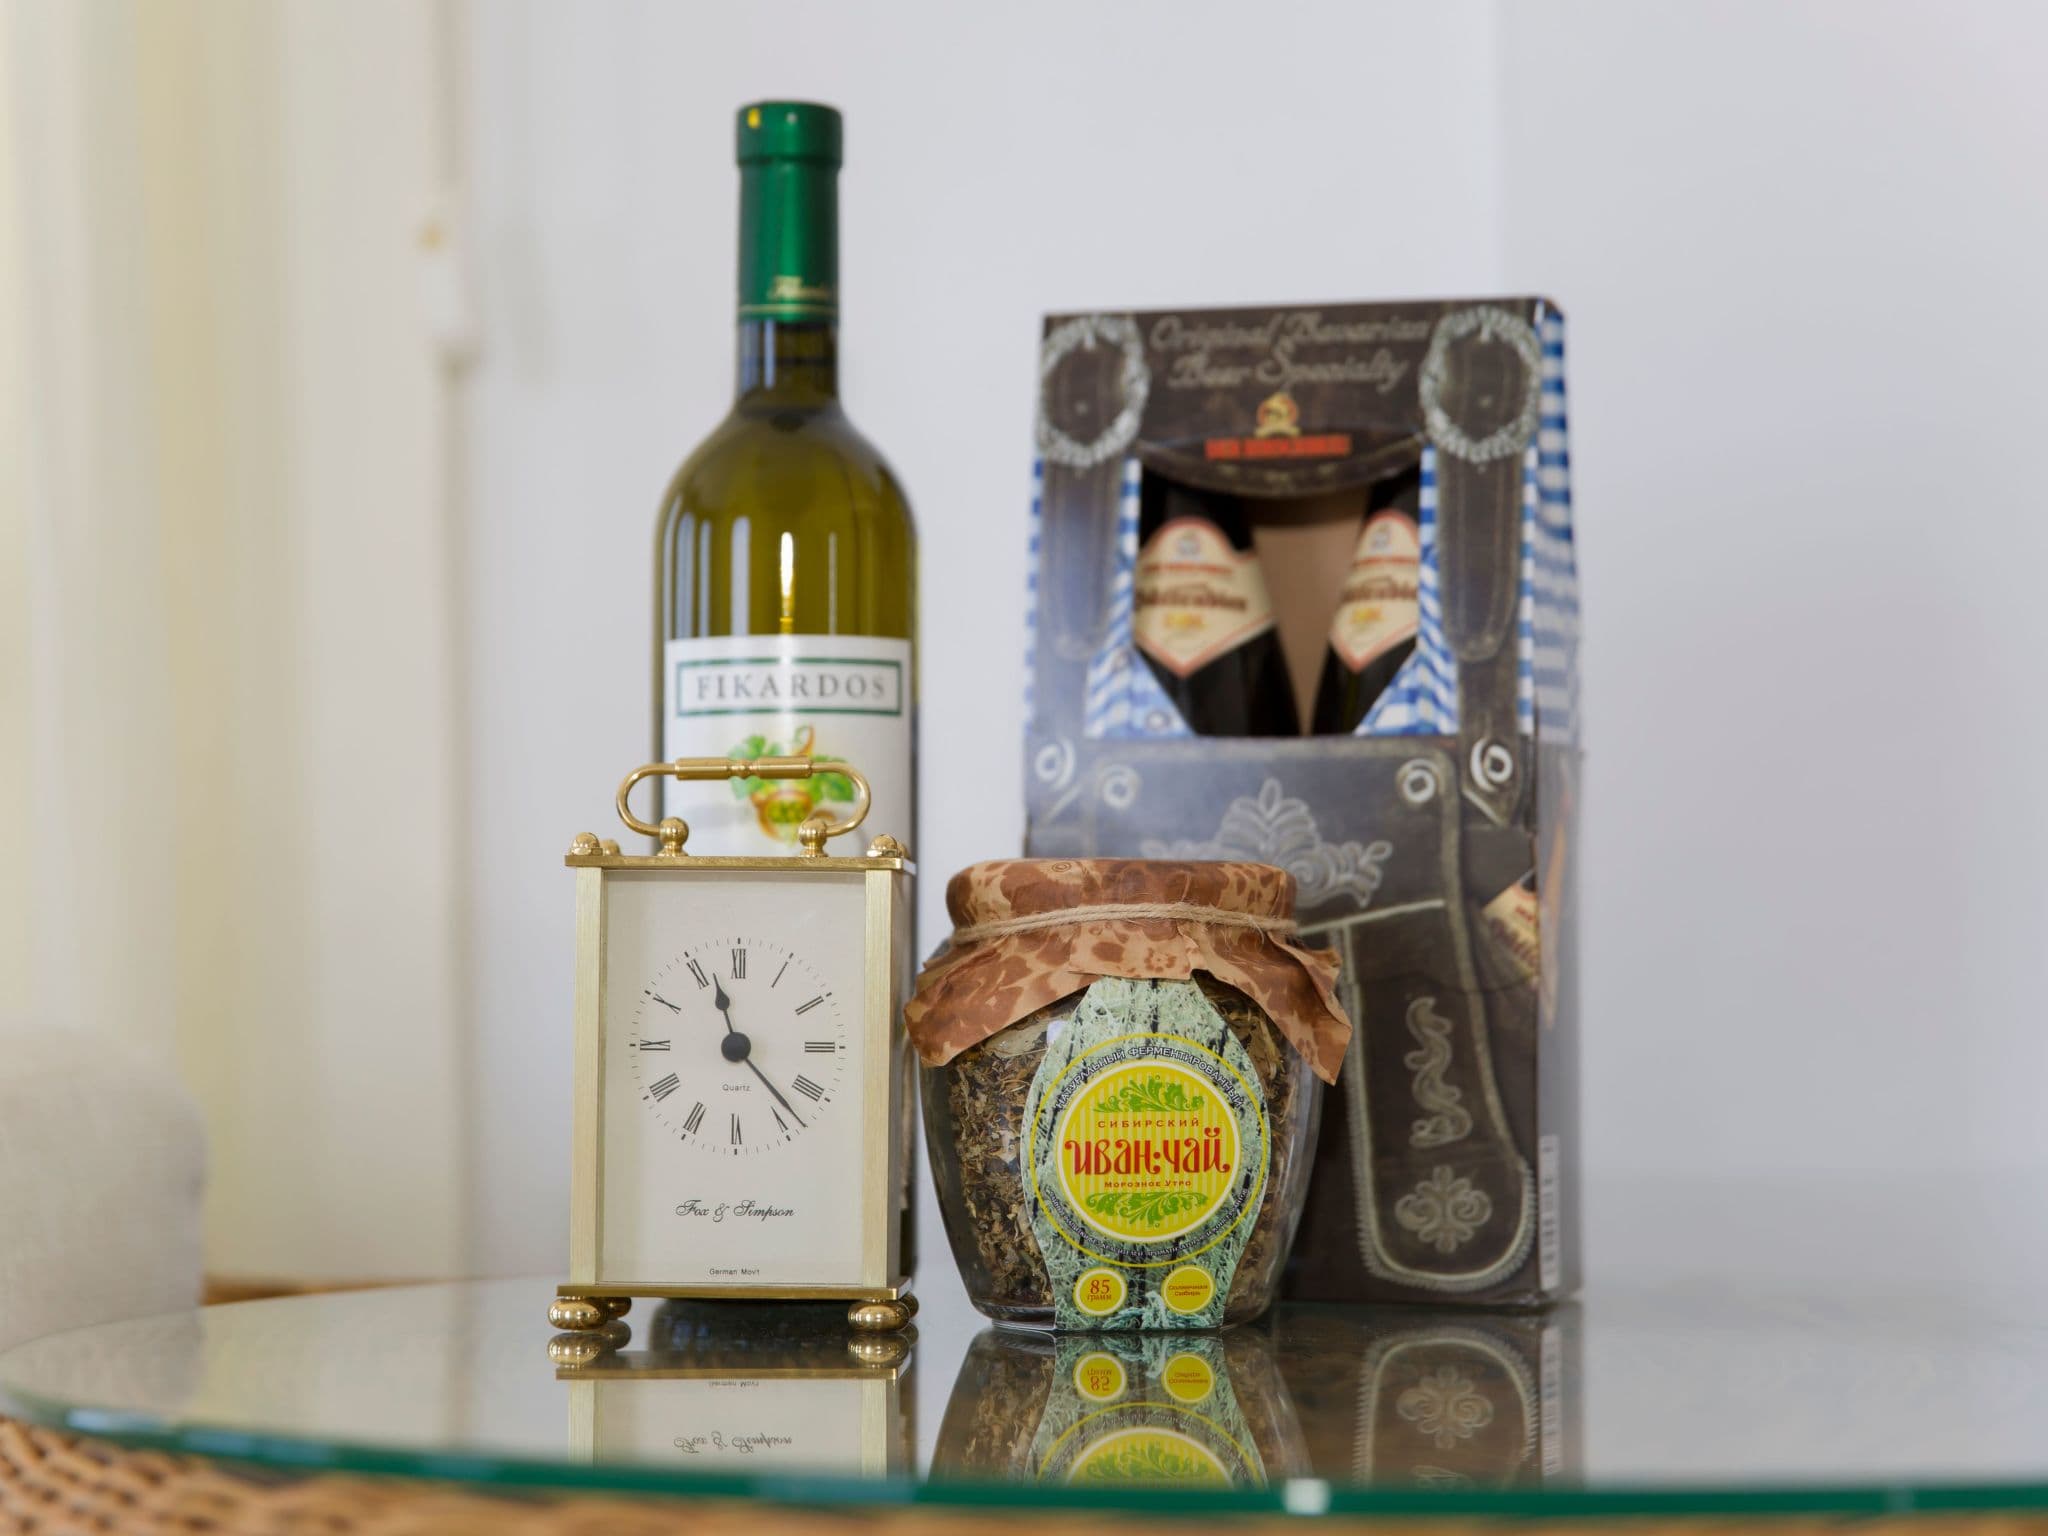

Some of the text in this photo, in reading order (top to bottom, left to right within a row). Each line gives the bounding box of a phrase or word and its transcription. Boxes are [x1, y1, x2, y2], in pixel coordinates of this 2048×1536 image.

[697, 673, 886, 700] FIKARDOS
[686, 958, 710, 990] XI
[731, 948, 746, 980] XII
[652, 993, 682, 1015] X
[795, 995, 824, 1016] II
[804, 1041, 835, 1053] III
[649, 1072, 681, 1102] VIII
[722, 1083, 751, 1093] Quartz
[792, 1074, 825, 1102] IIII
[1056, 1045, 1244, 1109] НАТУРАЛЬНЫЙ ФЕРМЕНТИРОВАННЫЙ
[683, 1101, 707, 1135] VII
[1098, 1117, 1200, 1128] СИБИРСКИЙ
[675, 1199, 794, 1222] Fox & Simpson
[709, 1267, 738, 1276] German
[1090, 1279, 1110, 1295] 85
